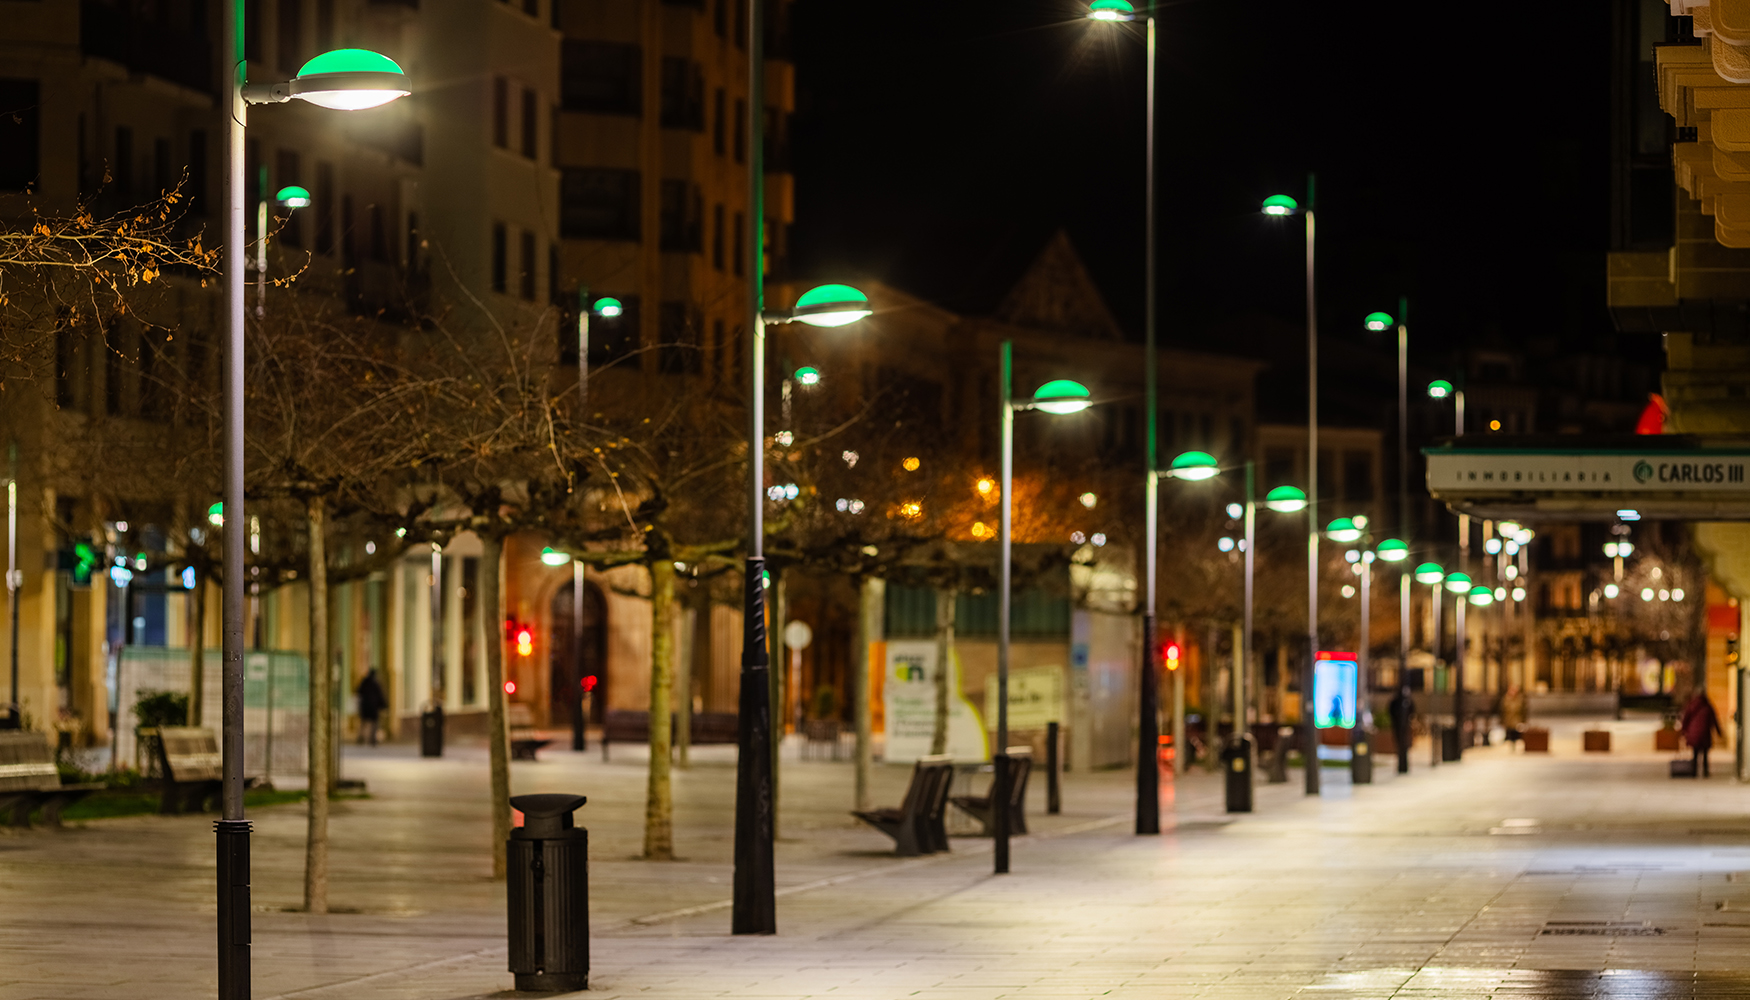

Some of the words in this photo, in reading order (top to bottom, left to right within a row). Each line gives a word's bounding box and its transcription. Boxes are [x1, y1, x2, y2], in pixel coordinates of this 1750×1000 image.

[1456, 470, 1611, 483] INMOBILIARIA
[1658, 463, 1724, 483] CARLOS
[1728, 463, 1745, 483] III
